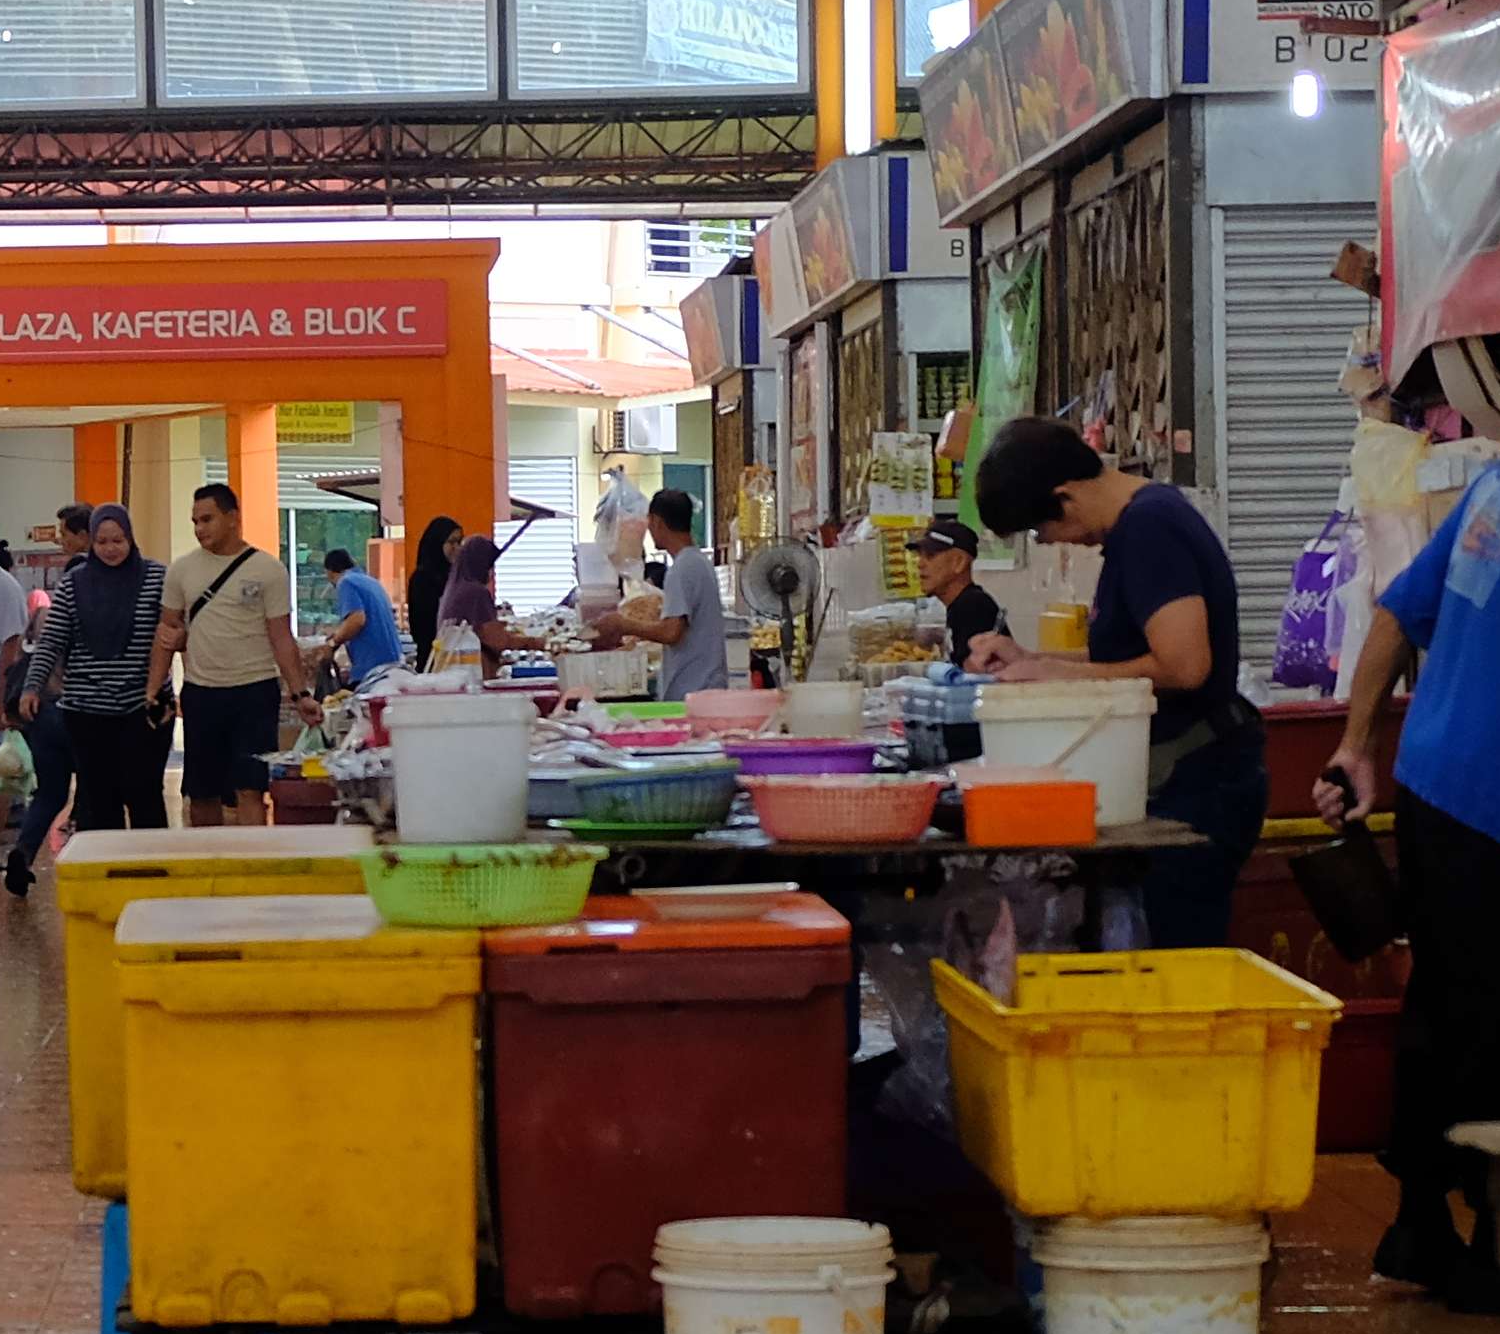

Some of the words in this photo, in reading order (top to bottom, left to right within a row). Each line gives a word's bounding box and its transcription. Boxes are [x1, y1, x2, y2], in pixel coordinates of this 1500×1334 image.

[93, 308, 259, 340] KAFETERIA
[269, 307, 293, 336] &
[304, 306, 386, 336] BLOK
[397, 305, 417, 335] C
